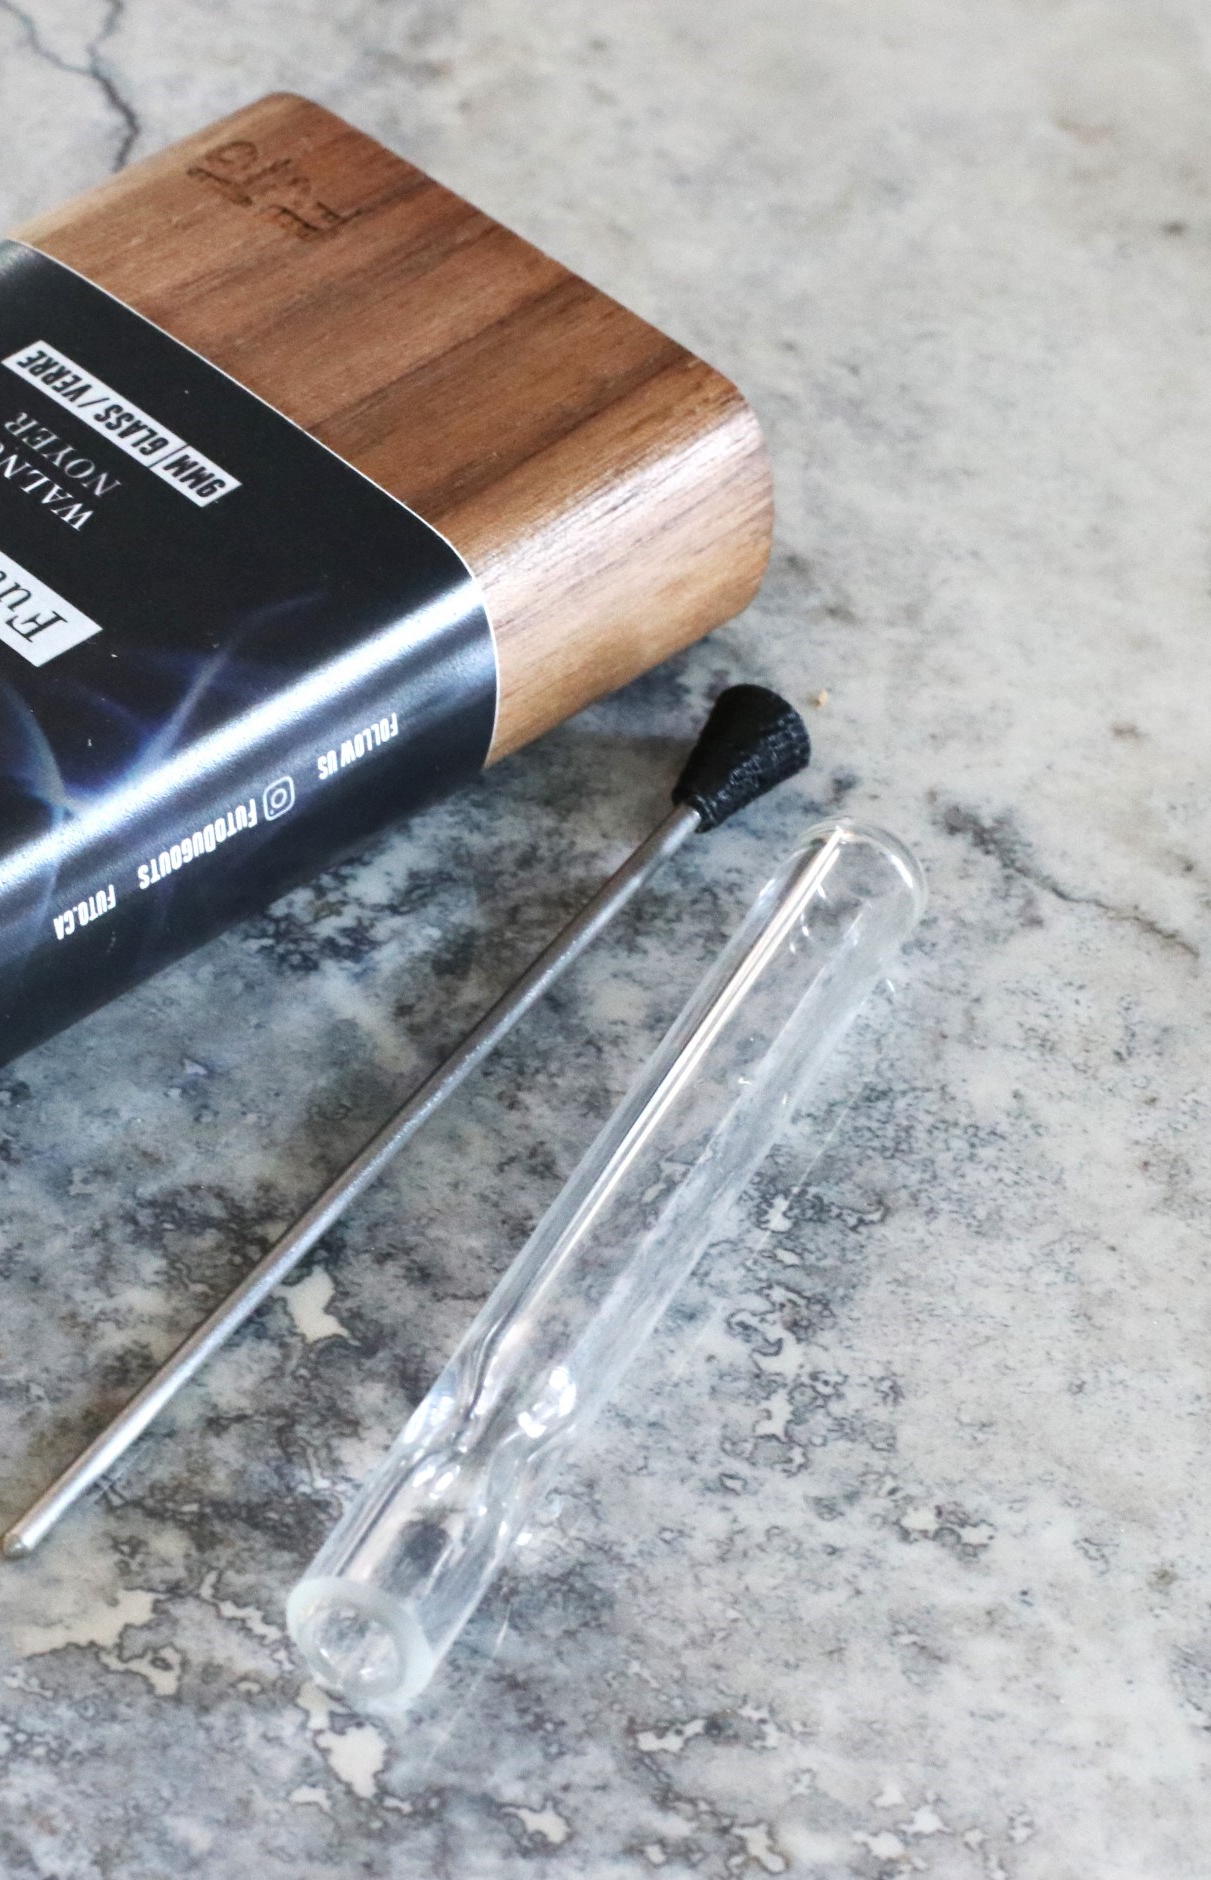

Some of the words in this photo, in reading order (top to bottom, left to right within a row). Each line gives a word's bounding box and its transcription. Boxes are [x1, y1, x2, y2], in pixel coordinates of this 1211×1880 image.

[18, 350, 92, 402] VERRE
[4, 411, 122, 497] NOYER
[94, 404, 169, 456] GLASS
[162, 453, 226, 497] 9MM
[317, 750, 338, 779] US
[341, 713, 399, 767] FOLLOW
[53, 884, 117, 940] FUTO.CA
